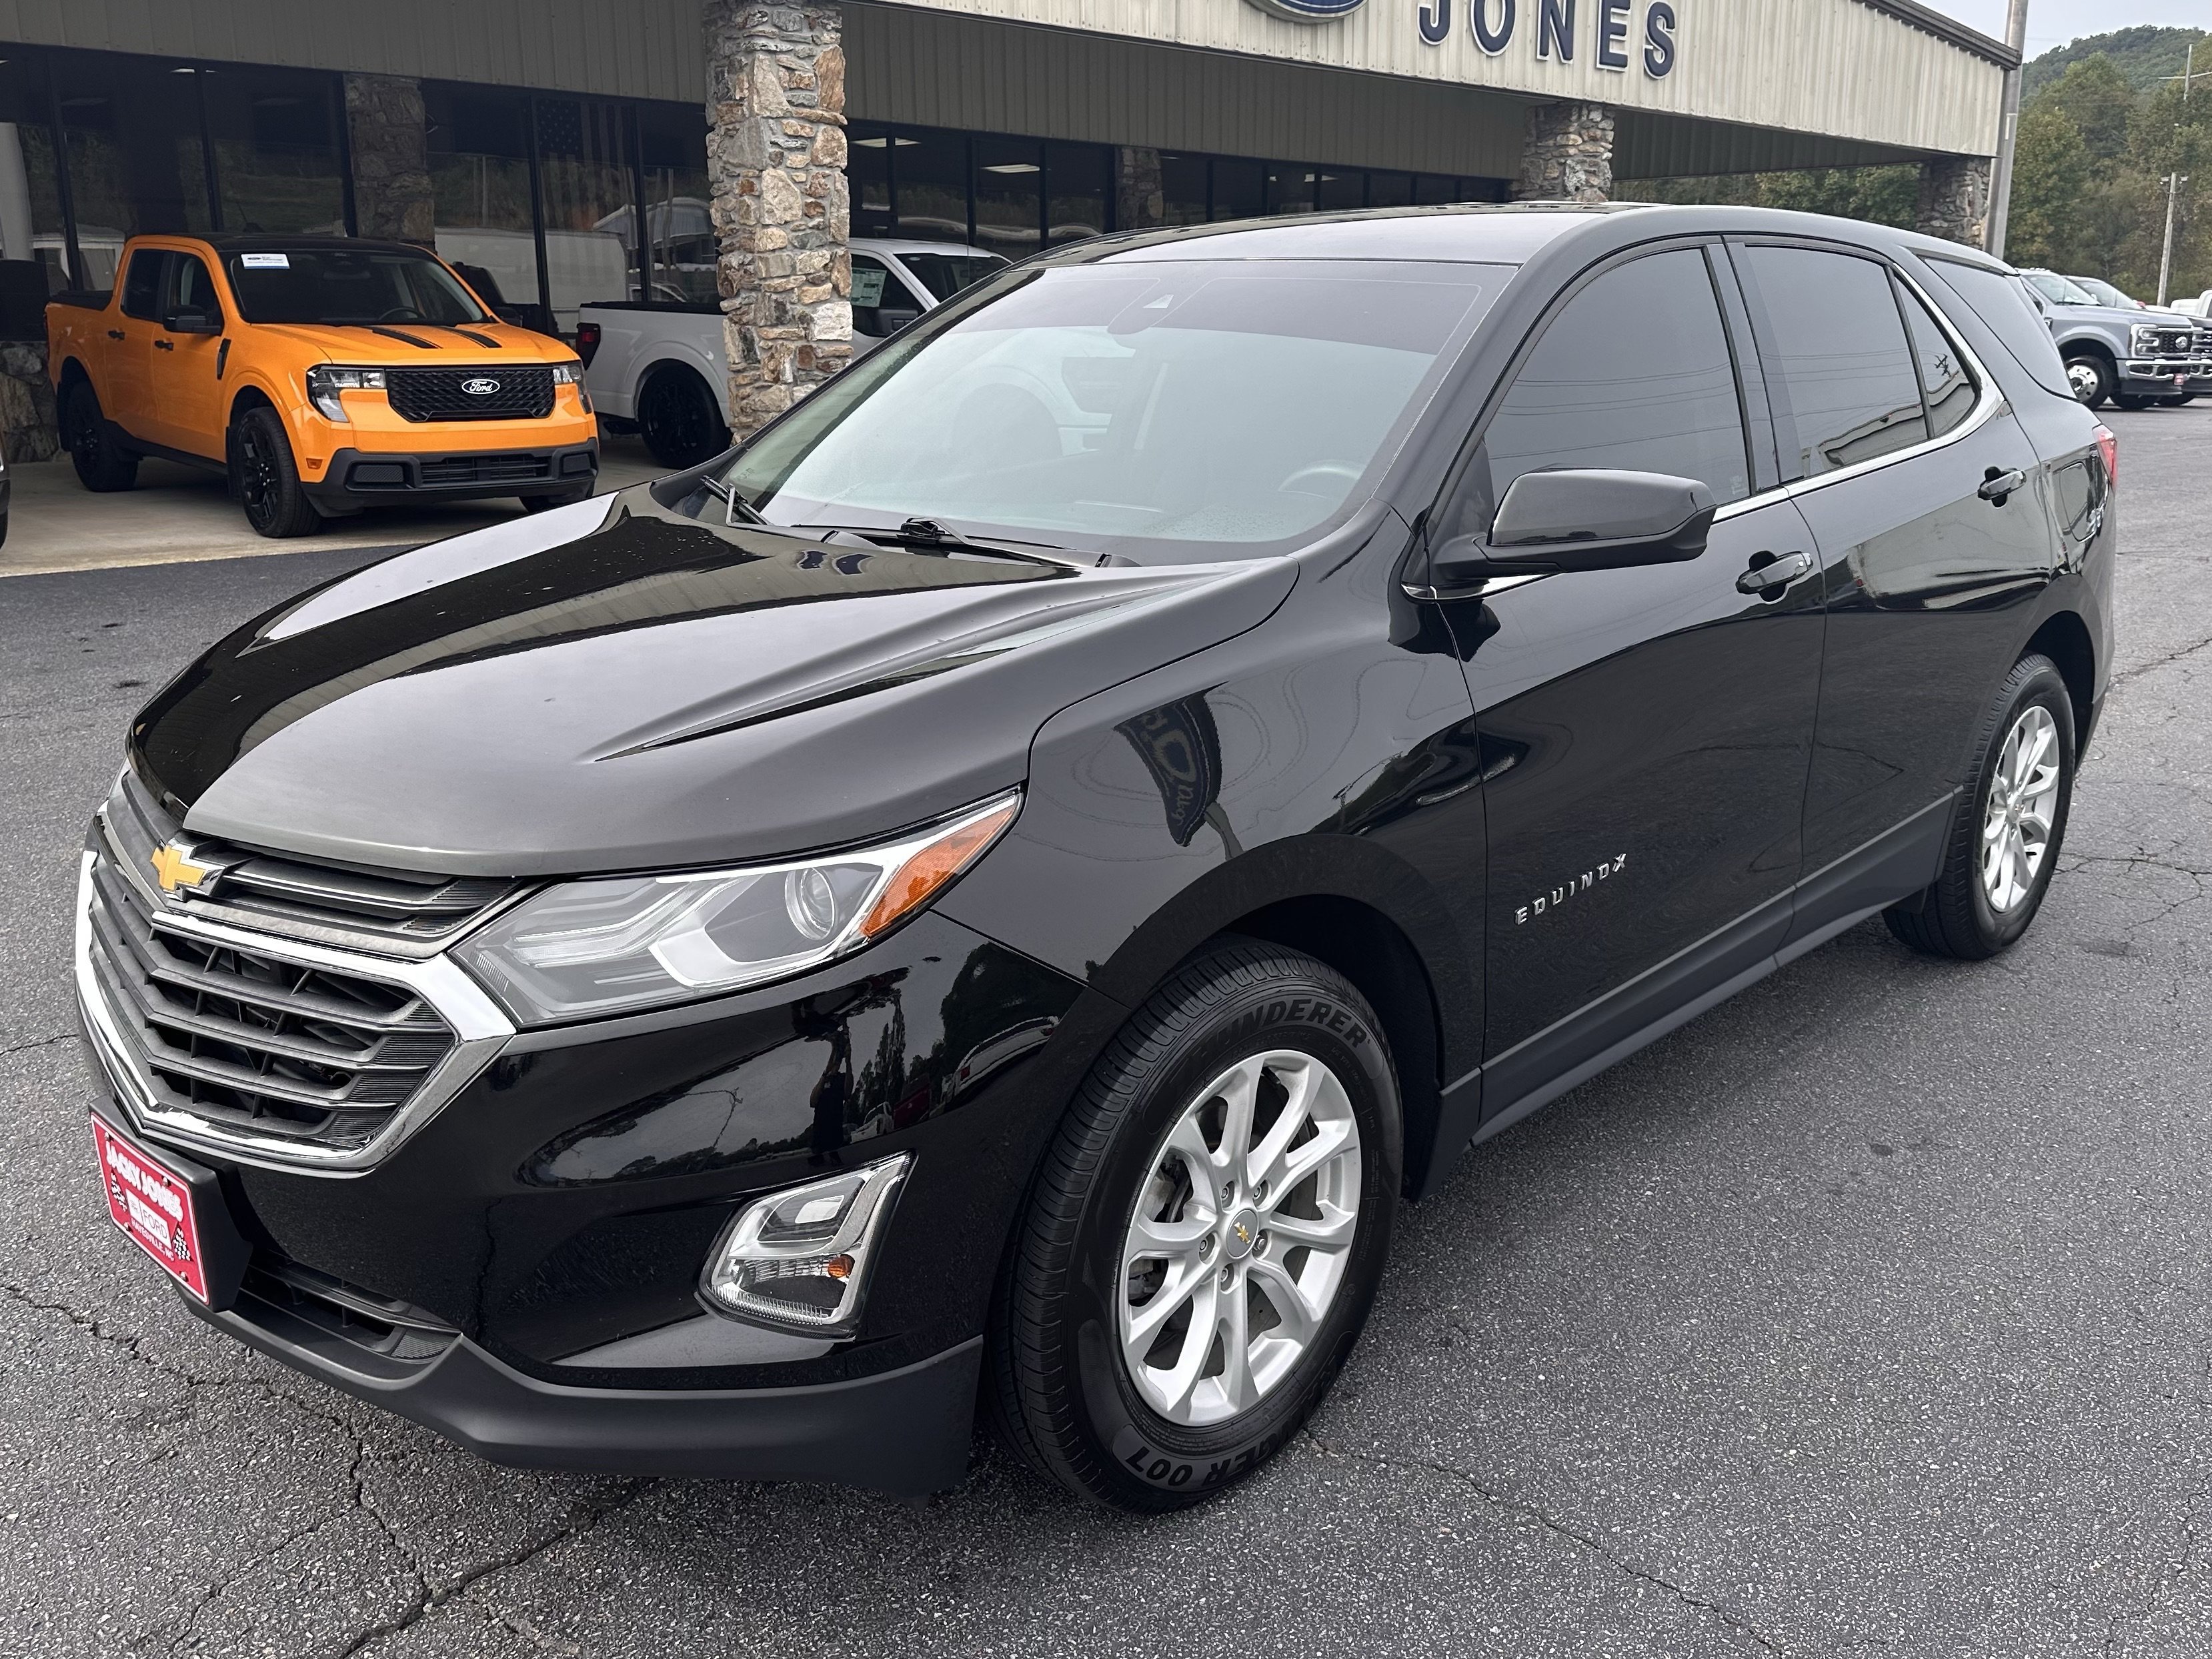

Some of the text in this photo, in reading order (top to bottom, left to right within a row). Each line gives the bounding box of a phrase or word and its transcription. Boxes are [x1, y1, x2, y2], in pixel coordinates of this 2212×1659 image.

[1418, 0, 1676, 79] JONES
[469, 381, 493, 392] Ford
[1514, 853, 1626, 926] EQUINOX
[141, 1170, 183, 1222] JONES
[143, 1210, 167, 1239] FORD
[1125, 1445, 1193, 1487] 007
